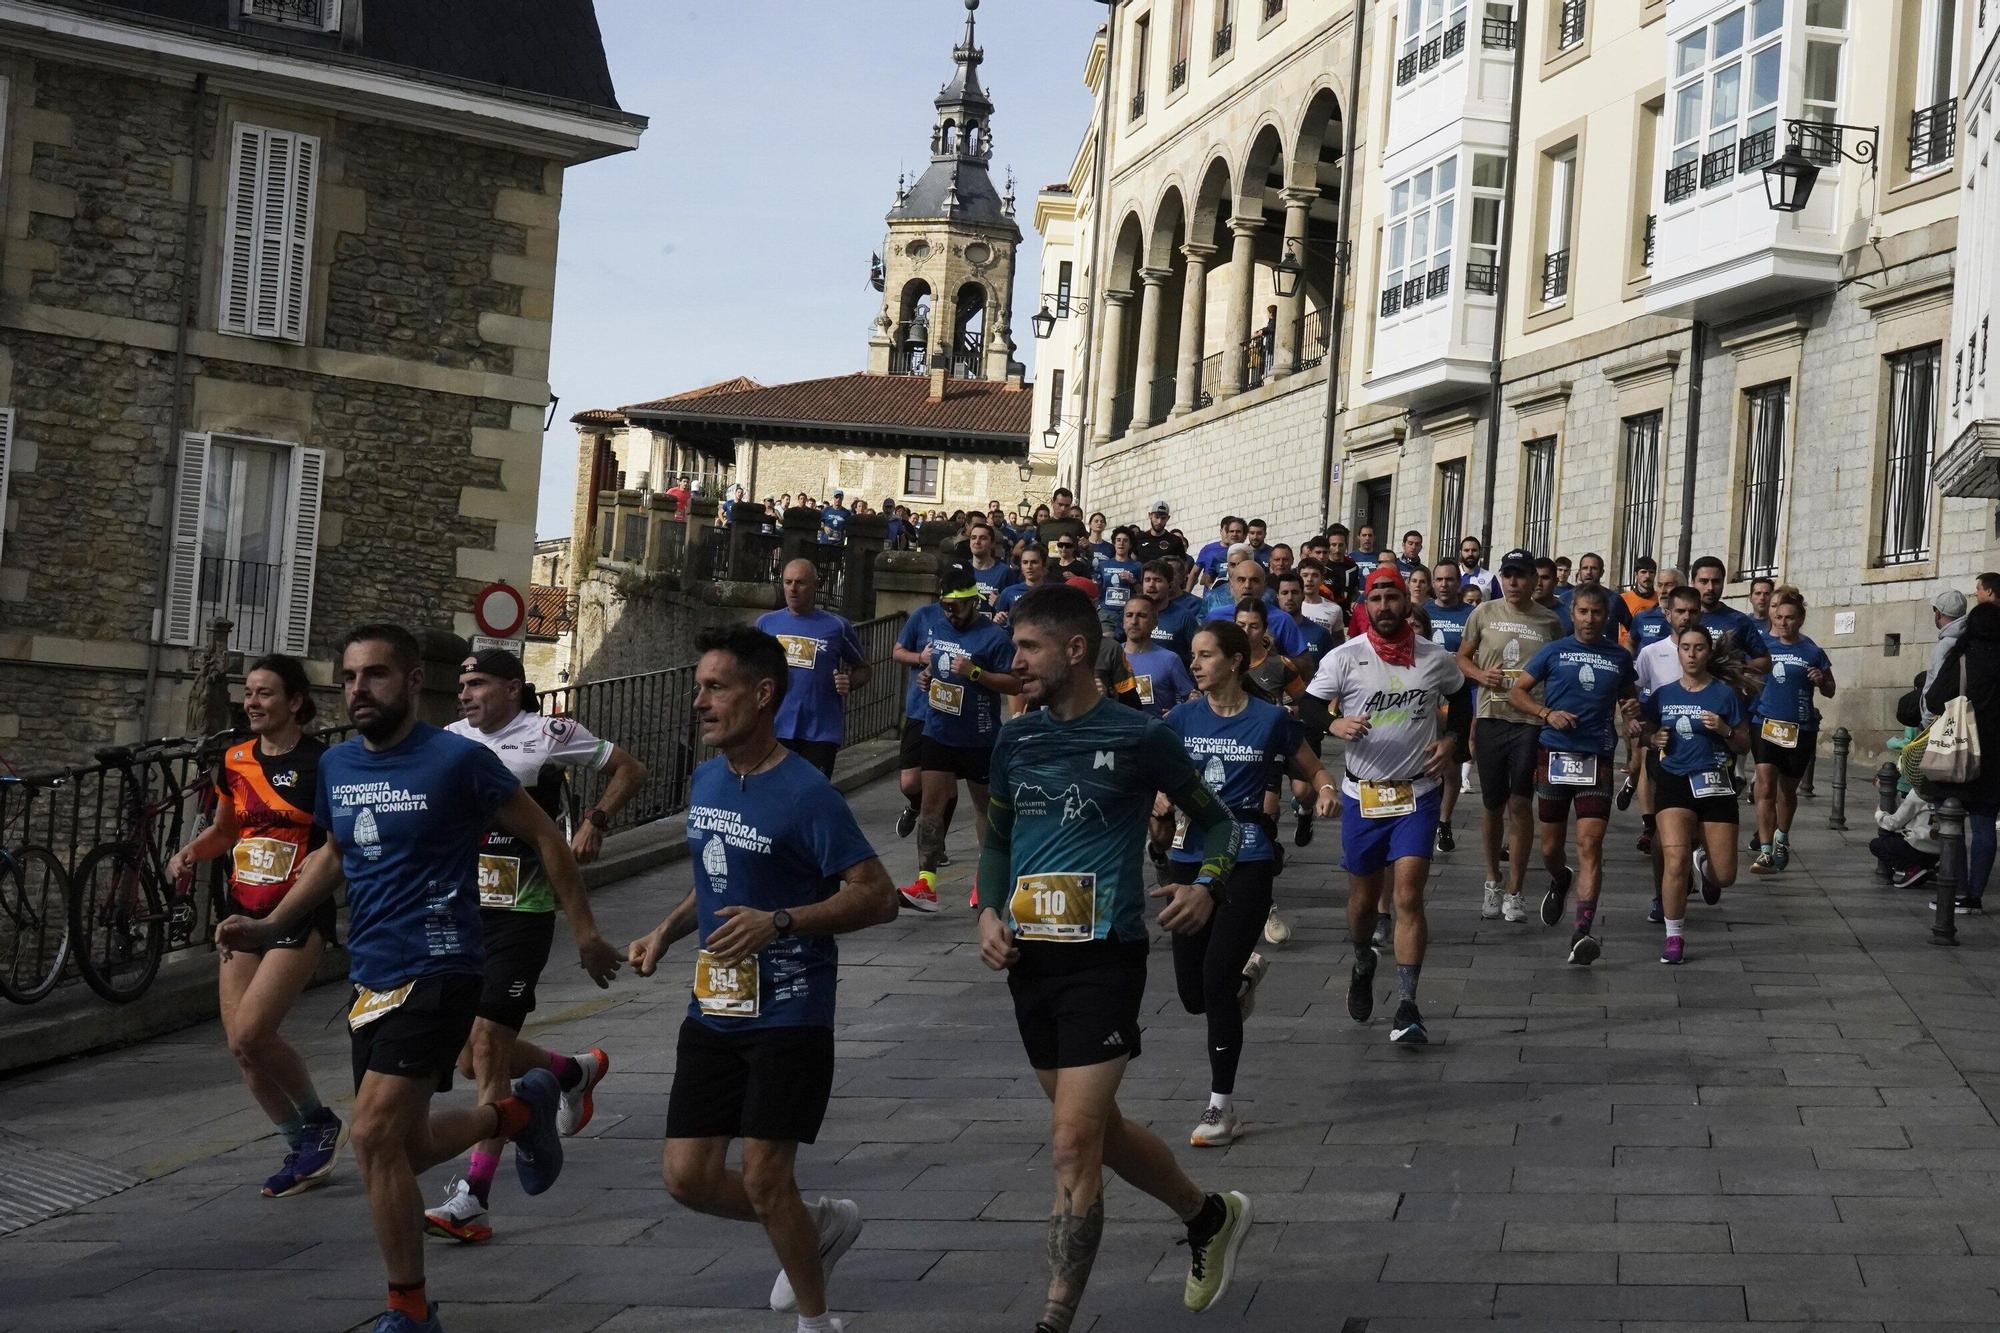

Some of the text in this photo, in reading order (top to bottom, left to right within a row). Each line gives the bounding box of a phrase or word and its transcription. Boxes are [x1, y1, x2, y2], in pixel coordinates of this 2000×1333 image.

[788, 642, 802, 655] 82
[1569, 656, 1613, 666] ALMENDRA
[936, 688, 953, 702] 303
[1365, 688, 1429, 713] ALDAPE
[1771, 726, 1789, 738] 434
[1191, 736, 1237, 747] CONQUISTA
[1193, 744, 1253, 755] ALMENDRA
[1223, 754, 1263, 762] KONKISTA
[1562, 760, 1584, 774] 753
[1701, 771, 1722, 785] 752
[332, 781, 391, 794] LA CONQUISTA
[341, 789, 412, 807] ALMENDRA
[411, 793, 427, 801] REN
[1377, 787, 1397, 803] 39
[375, 800, 429, 814] KONKISTA
[696, 806, 742, 824] CONQUISTA
[693, 817, 757, 841] ALMENDRA
[757, 835, 773, 845] REN
[487, 836, 515, 844] LIMIT
[724, 834, 772, 855] KONKISTA
[246, 847, 275, 869] 155
[1032, 890, 1065, 916] 110
[708, 966, 740, 992] 354
